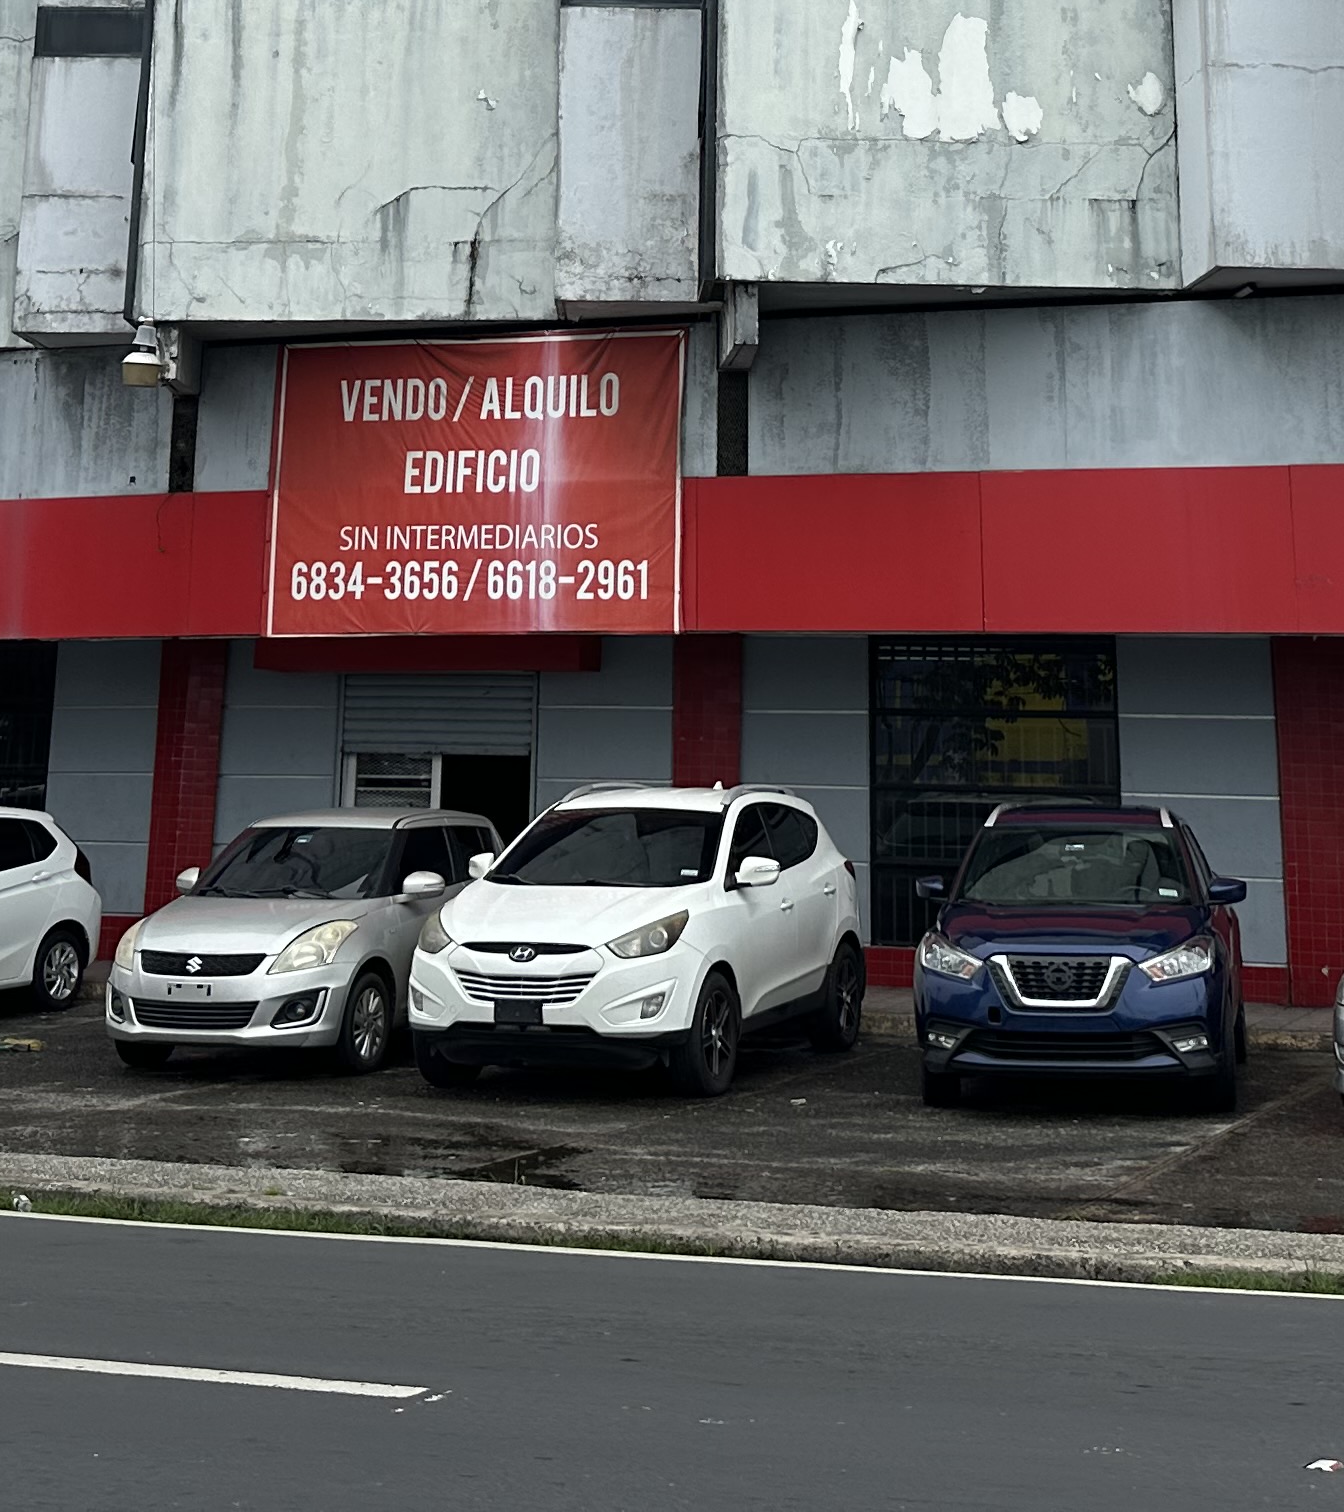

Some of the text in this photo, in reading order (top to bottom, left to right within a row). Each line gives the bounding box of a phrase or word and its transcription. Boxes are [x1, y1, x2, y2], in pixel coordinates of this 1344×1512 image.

[340, 377, 448, 422] VENDO
[479, 372, 620, 420] ALQUILO
[403, 448, 541, 494] EDIFICIO
[339, 523, 599, 551] SIN INTERMEDIARIOS
[290, 560, 459, 601] 6834-3656
[487, 558, 649, 600] 6618-2961
